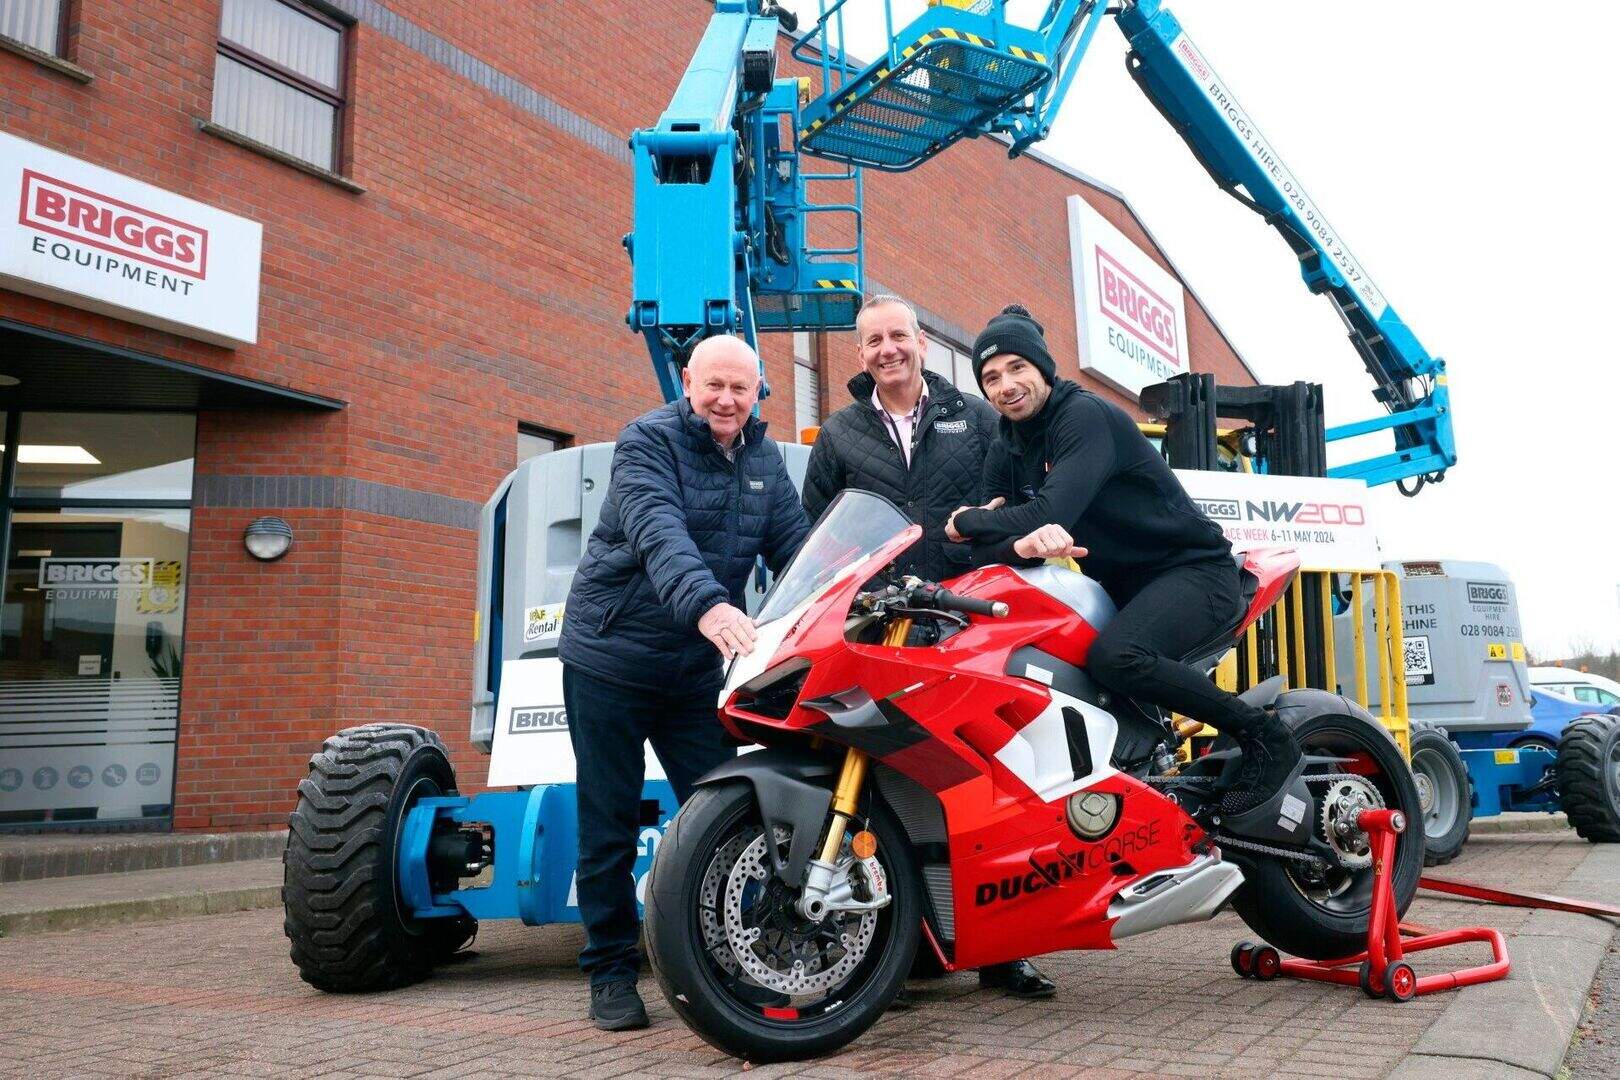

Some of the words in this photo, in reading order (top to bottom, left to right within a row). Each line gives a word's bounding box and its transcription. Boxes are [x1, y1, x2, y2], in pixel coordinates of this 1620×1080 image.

[1208, 83, 1253, 141] BRIGGS
[1283, 180, 1306, 211] 028
[1306, 210, 1333, 247] 9084
[1333, 250, 1362, 282] 2537
[35, 186, 197, 264] BRIGGS
[32, 235, 194, 296] EQUIPMENT
[1103, 265, 1175, 349] BRIGGS
[1245, 500, 1365, 526] NW200
[1224, 528, 1242, 541] ACE
[1243, 529, 1269, 541] WEEK
[1271, 529, 1292, 542] 6-11
[1294, 530, 1312, 543] MAY
[1313, 531, 1335, 543] 2024
[47, 564, 146, 582] BRIGGS
[1470, 587, 1507, 600] BRIGGS
[1407, 604, 1436, 615] THIS
[1485, 613, 1502, 621] HIRE
[528, 618, 558, 634] Rental
[1461, 625, 1480, 636] 028
[1482, 626, 1504, 637] 9084
[1088, 818, 1160, 869] CORSE
[870, 861, 883, 892] brembo
[975, 851, 1085, 906] DUCATI
